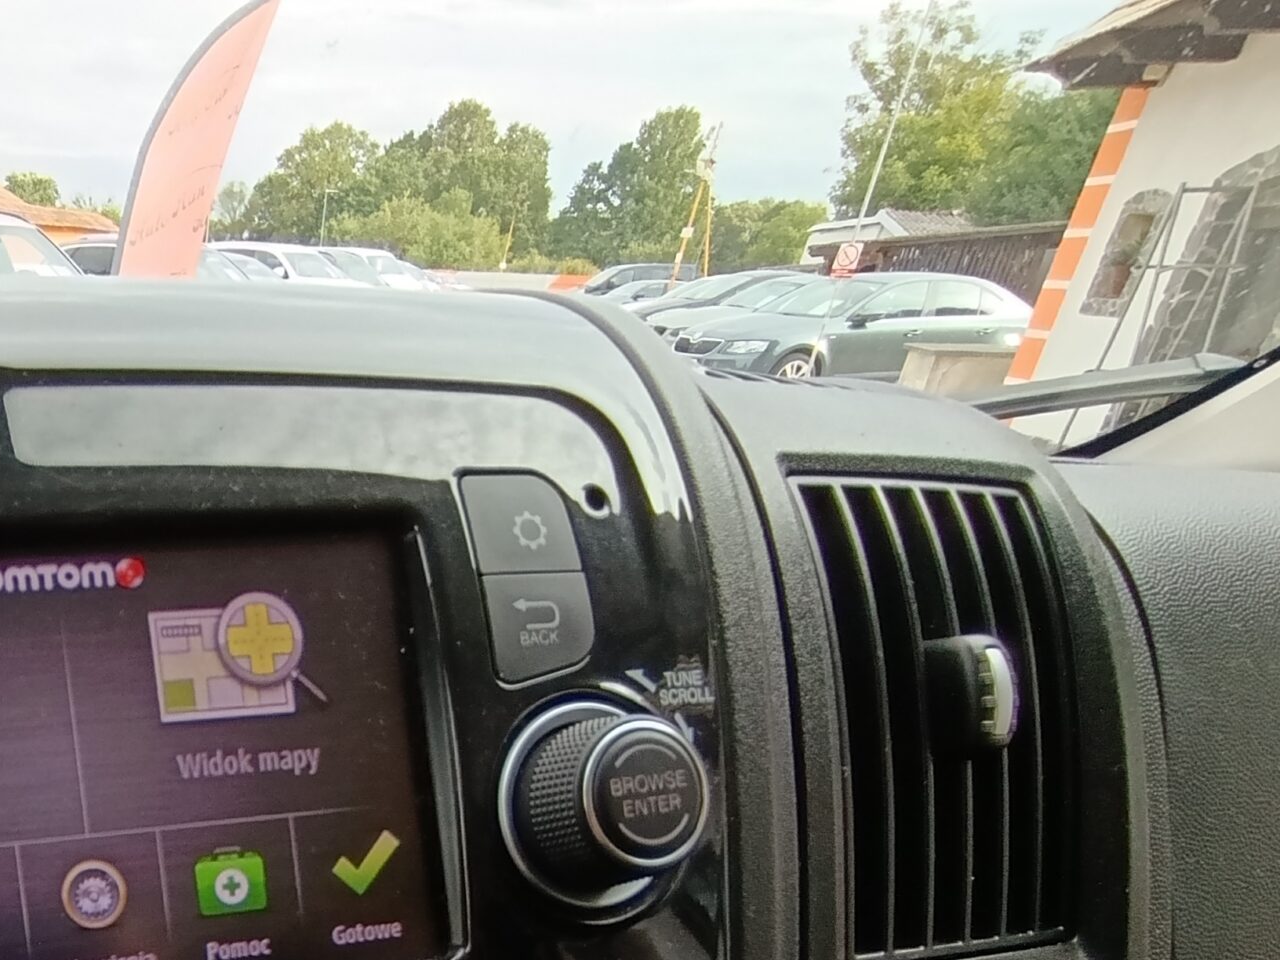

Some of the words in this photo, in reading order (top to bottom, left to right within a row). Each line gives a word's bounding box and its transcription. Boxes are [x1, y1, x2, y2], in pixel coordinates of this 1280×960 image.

[520, 630, 559, 645] BACK
[663, 670, 704, 687] TUNE
[659, 687, 716, 705] SCROLL
[177, 748, 254, 779] Widok
[260, 746, 321, 776] mapy
[609, 770, 688, 796] BROWSE
[622, 796, 683, 819] ENTER
[331, 919, 403, 947] Gotowe
